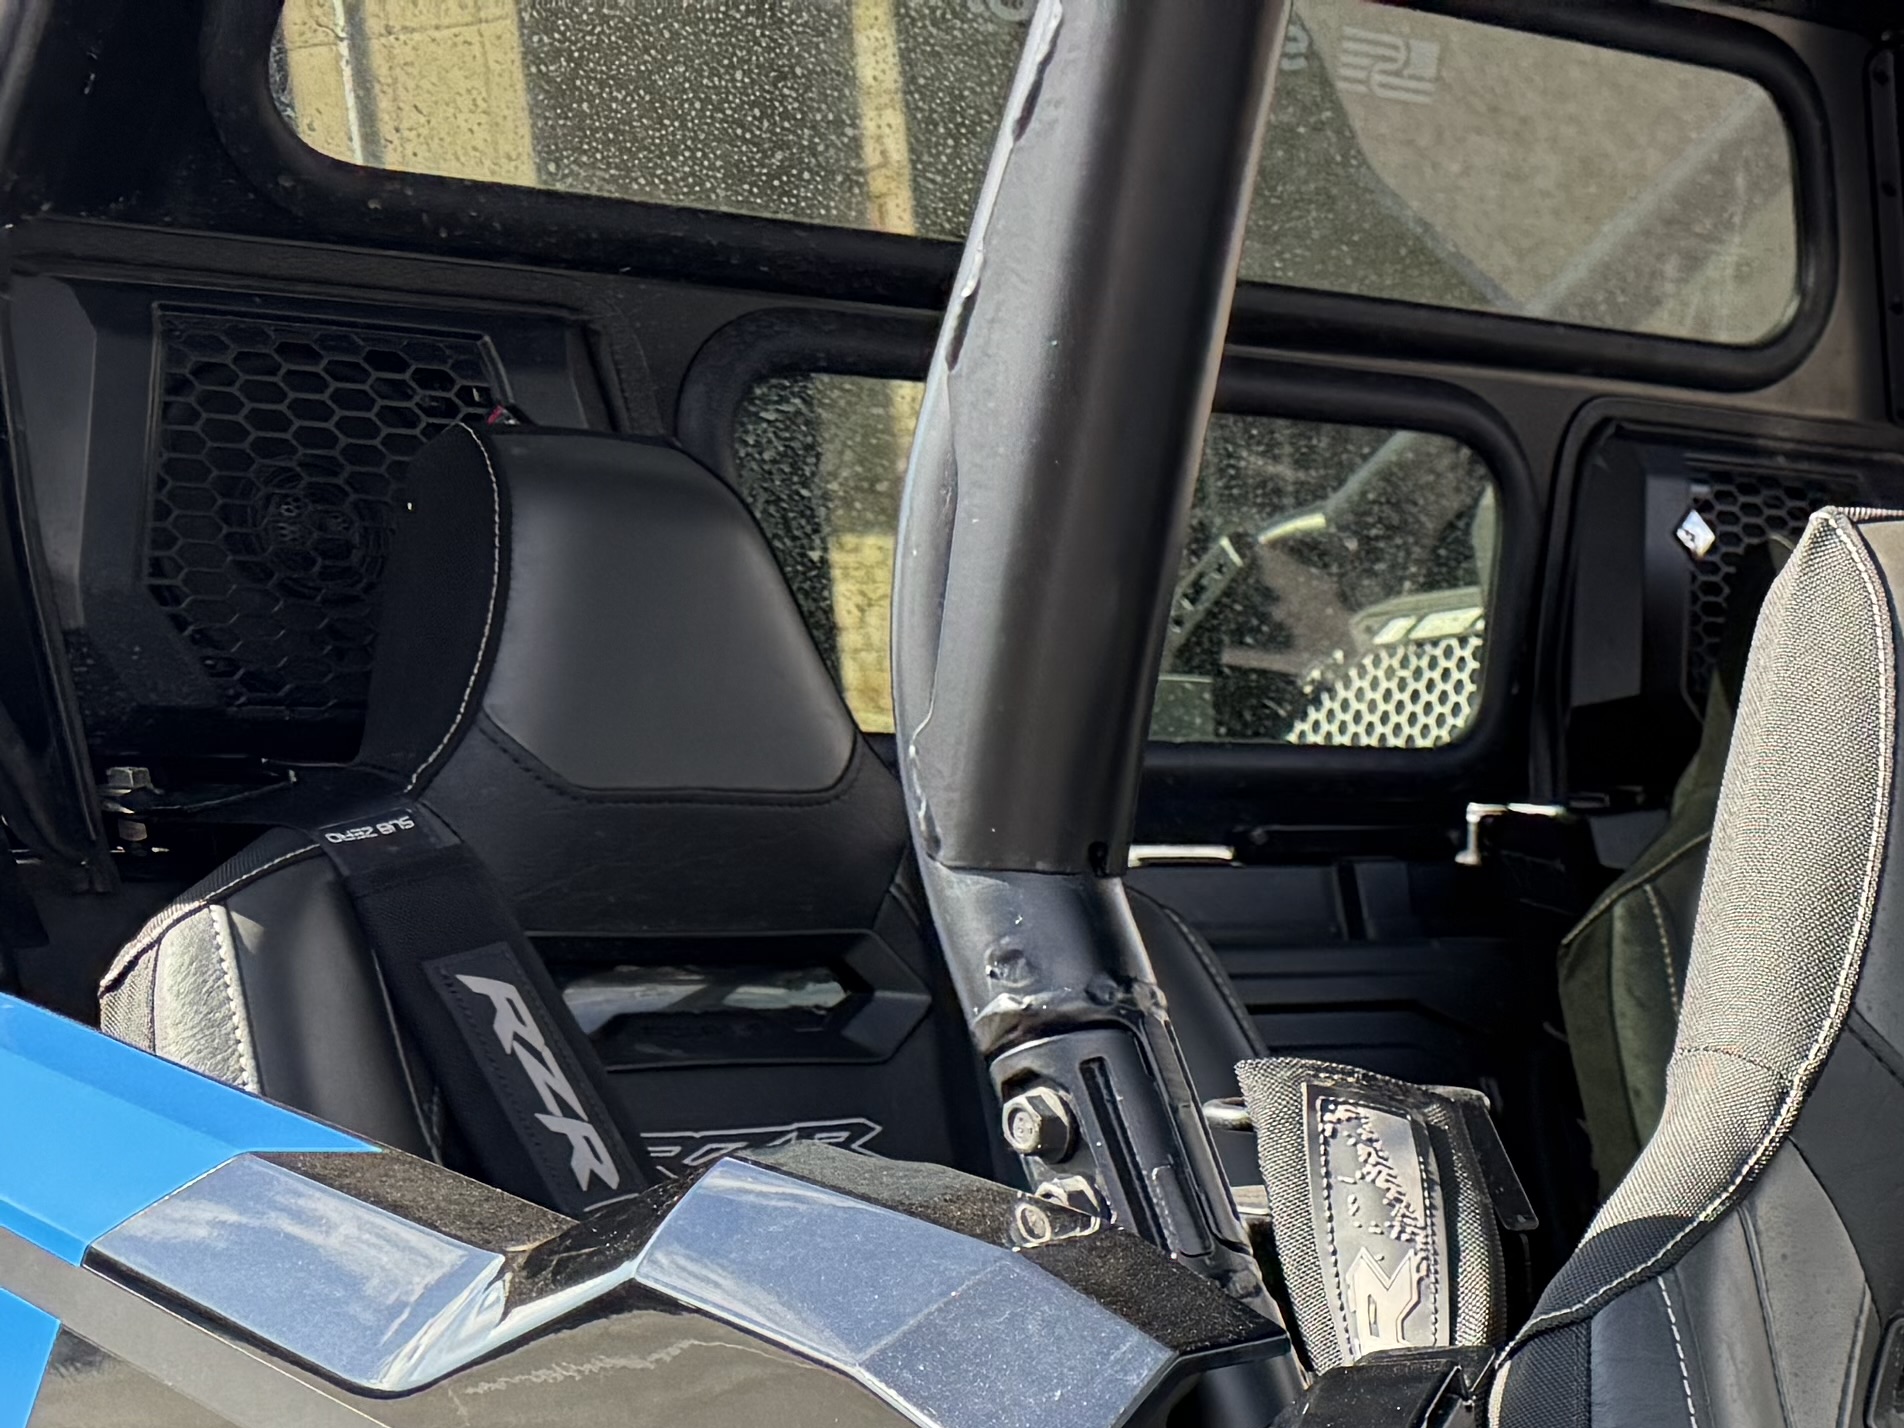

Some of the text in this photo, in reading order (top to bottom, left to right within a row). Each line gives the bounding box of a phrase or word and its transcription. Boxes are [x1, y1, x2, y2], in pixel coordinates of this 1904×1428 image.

[325, 815, 416, 844] SUB ZERO
[456, 974, 620, 1192] RZR
